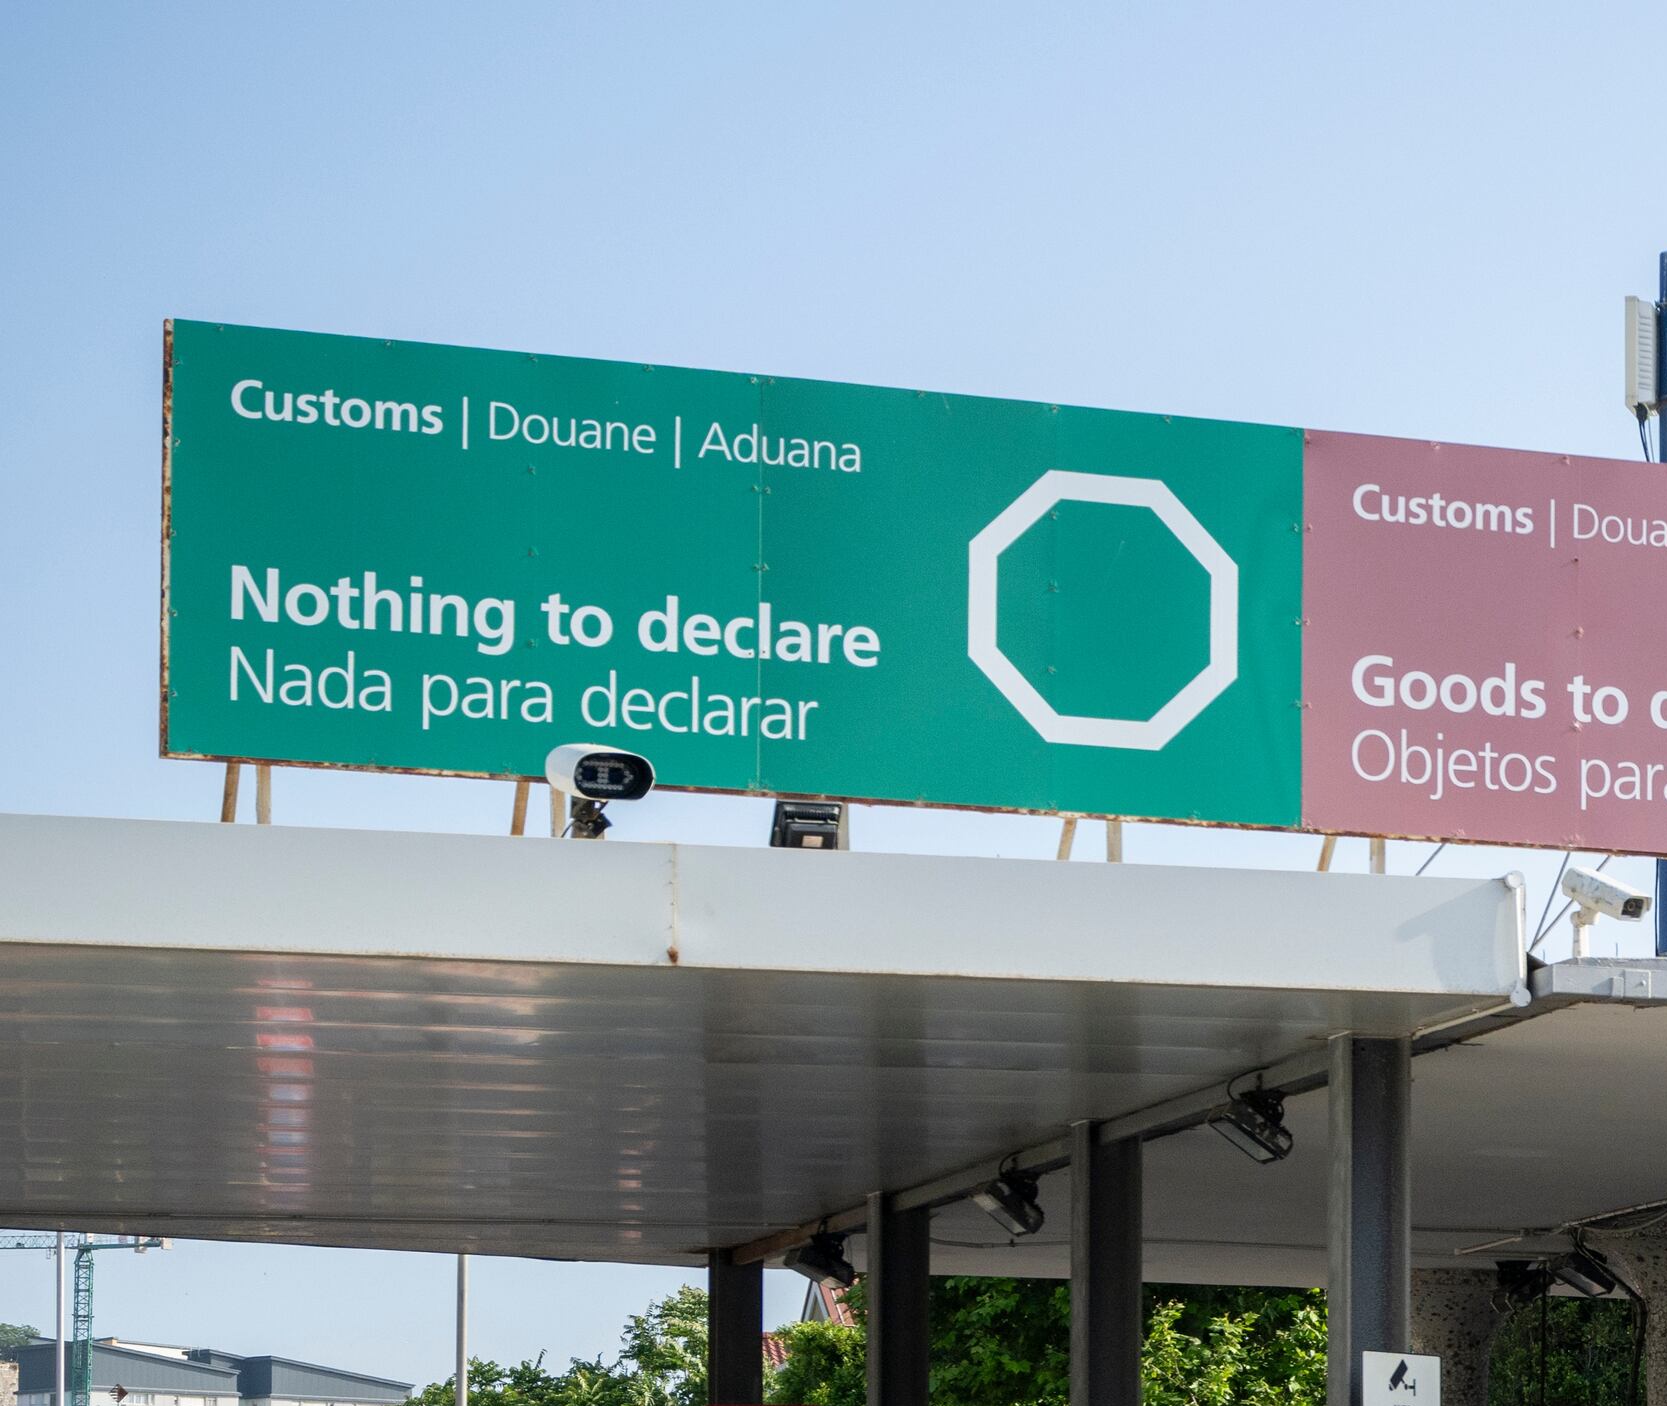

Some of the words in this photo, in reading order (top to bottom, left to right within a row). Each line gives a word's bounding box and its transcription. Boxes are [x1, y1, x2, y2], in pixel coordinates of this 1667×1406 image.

[229, 379, 445, 437] Customs
[488, 401, 657, 456] Douane
[699, 422, 863, 473] Aduana
[1352, 483, 1534, 534] Customs
[229, 565, 517, 656] Nothing
[542, 593, 614, 649] to
[637, 594, 881, 669] declare
[229, 646, 394, 714] Nada
[421, 672, 553, 731] para
[581, 669, 819, 742] declarar
[1352, 654, 1547, 720] Goods
[1567, 674, 1629, 726] to
[1352, 729, 1557, 801] Objetos
